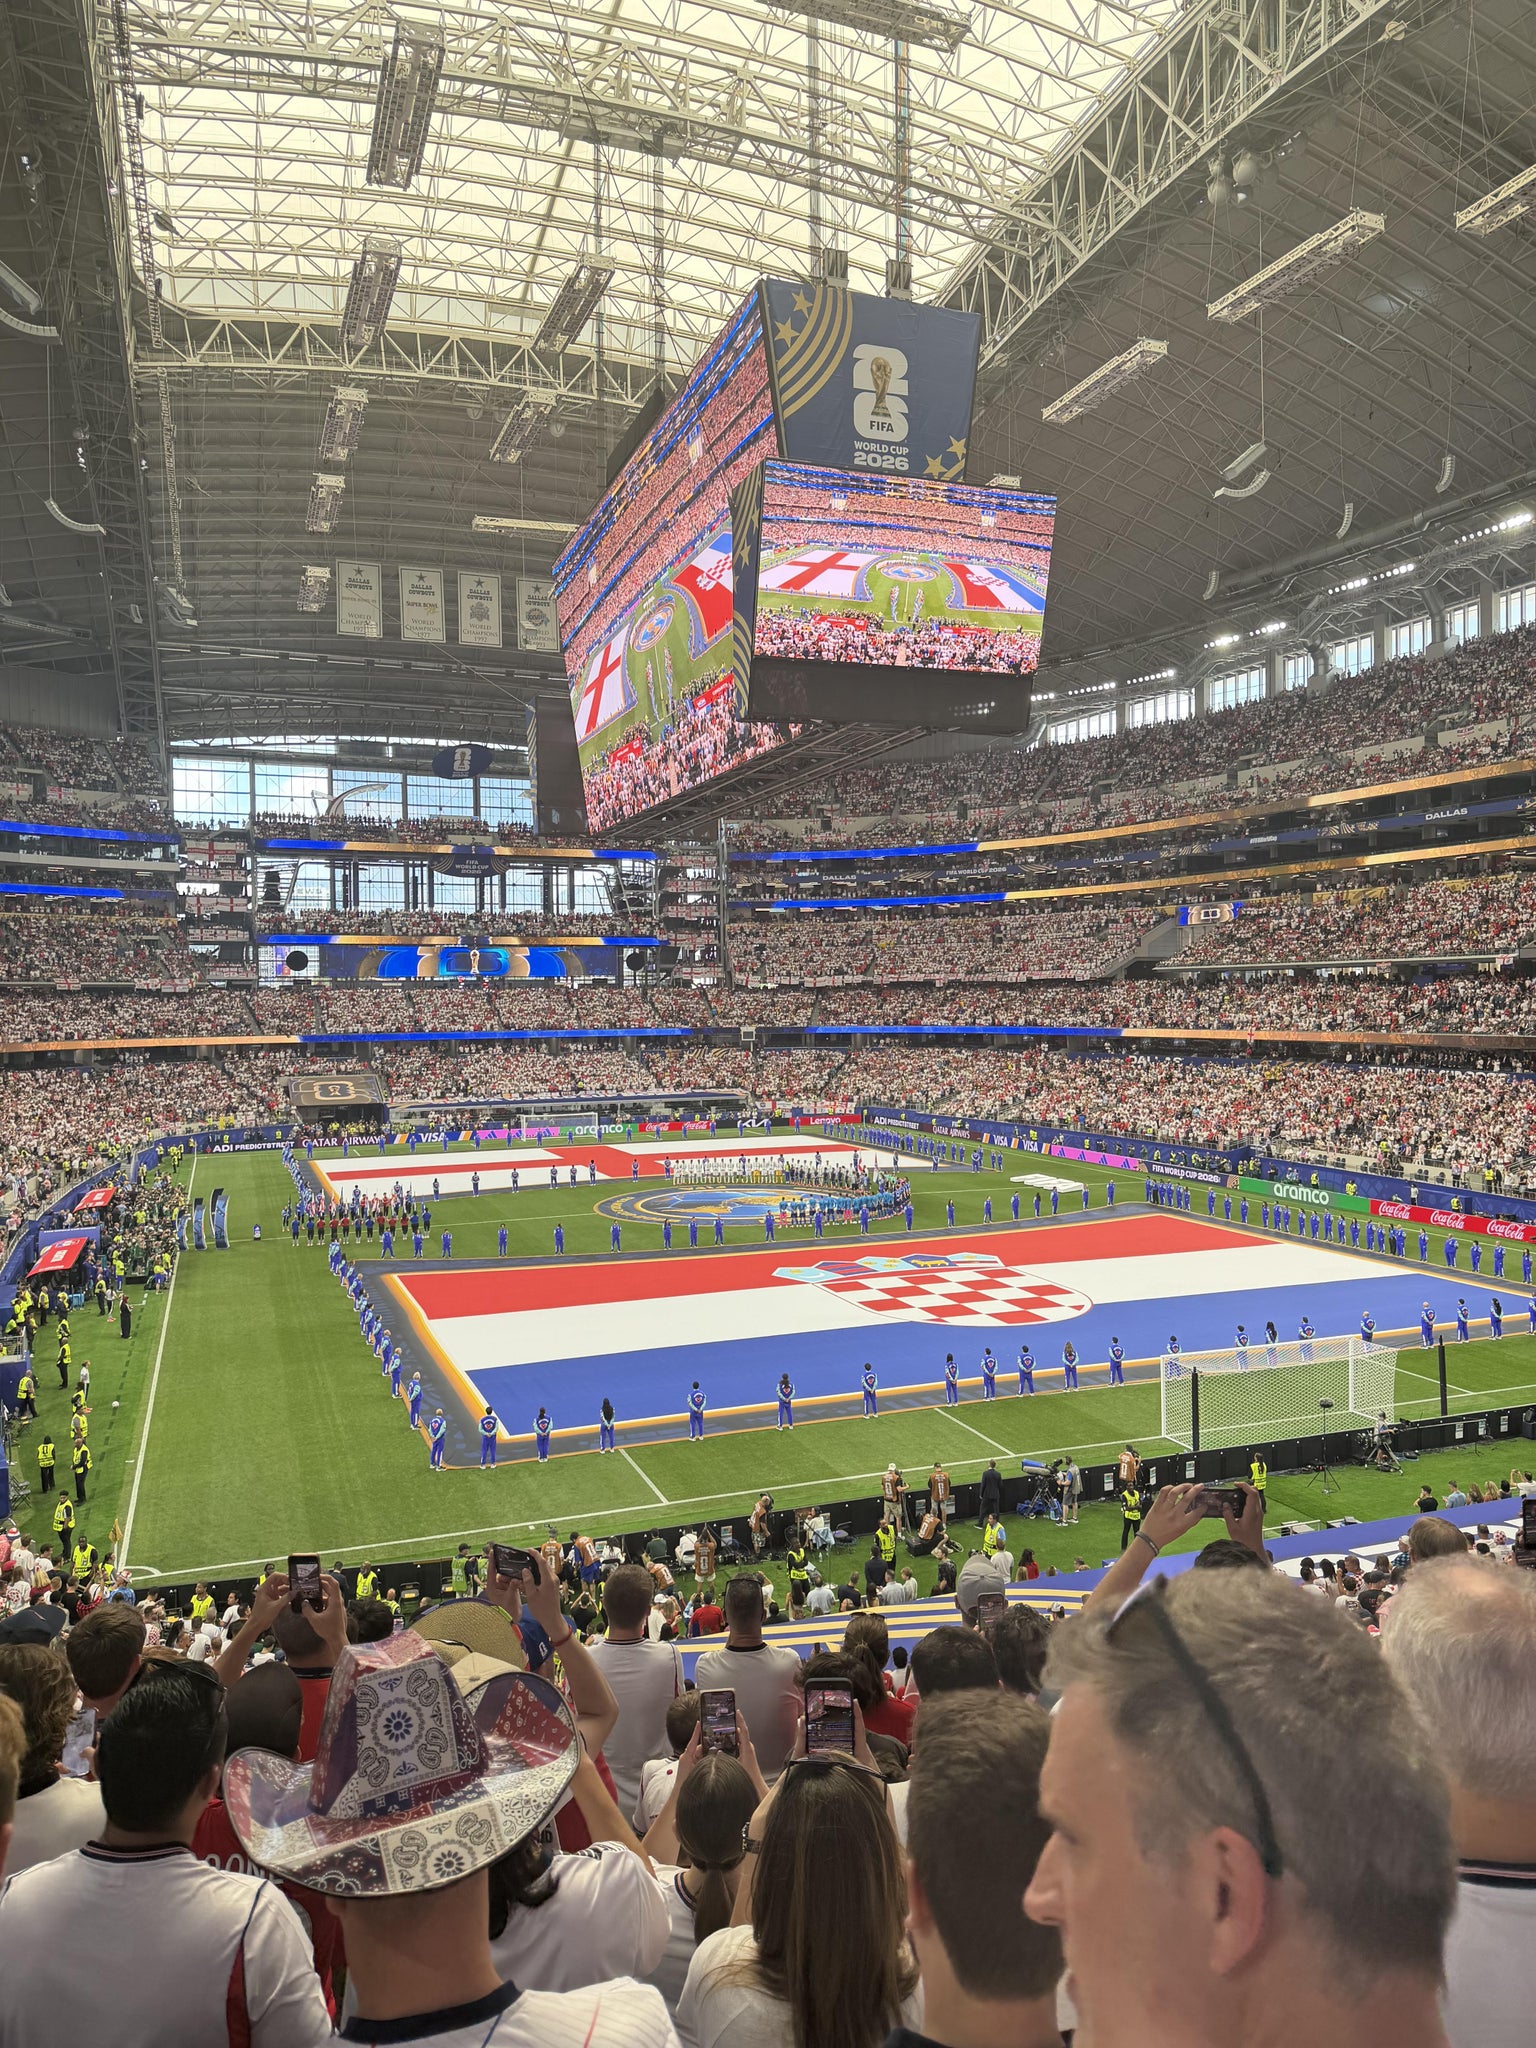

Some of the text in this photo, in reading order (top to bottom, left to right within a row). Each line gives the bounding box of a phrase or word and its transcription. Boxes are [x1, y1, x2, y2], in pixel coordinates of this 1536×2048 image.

[870, 420, 894, 433] FIFA
[854, 440, 909, 456] WORLD CUP
[853, 451, 910, 471] 2026
[463, 629, 498, 637] CHAMPIONS
[1425, 808, 1468, 820] DALLAS
[1093, 855, 1124, 864] DALLAS
[810, 1117, 841, 1125] Lenovo
[874, 1116, 887, 1126] ADI
[932, 1126, 970, 1139] QATAR AIRWAYS
[342, 1136, 385, 1146] AIRWAY
[992, 1135, 1008, 1147] VISA
[1023, 1139, 1038, 1152] VISA
[213, 1144, 233, 1153] ADI
[1152, 1164, 1219, 1183] FIFA WORLD CUP 2026
[1273, 1183, 1329, 1206] aramco
